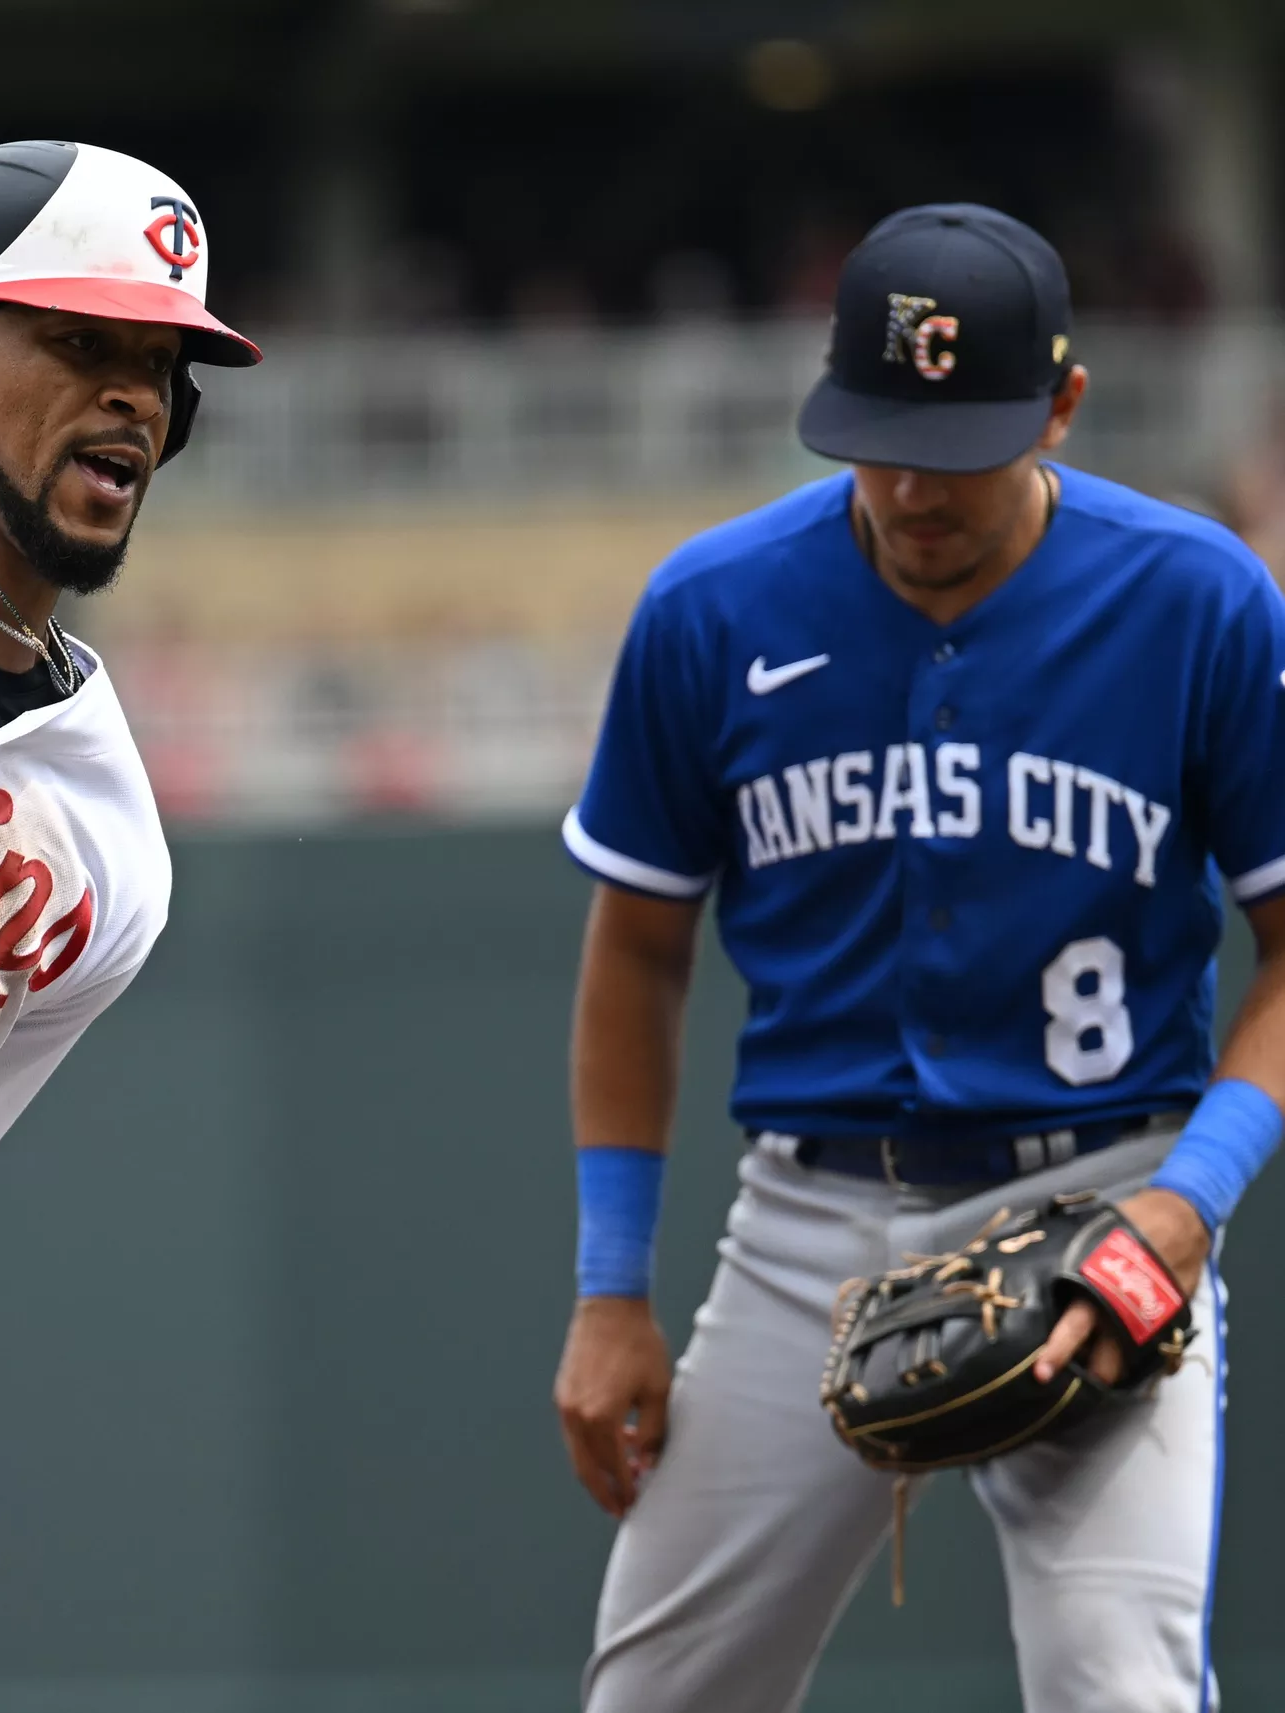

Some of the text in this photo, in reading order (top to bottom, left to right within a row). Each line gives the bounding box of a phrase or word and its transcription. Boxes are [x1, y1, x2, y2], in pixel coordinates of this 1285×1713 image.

[881, 293, 960, 381] KC
[1007, 751, 1172, 888] CITY
[1041, 936, 1135, 1087] 8
